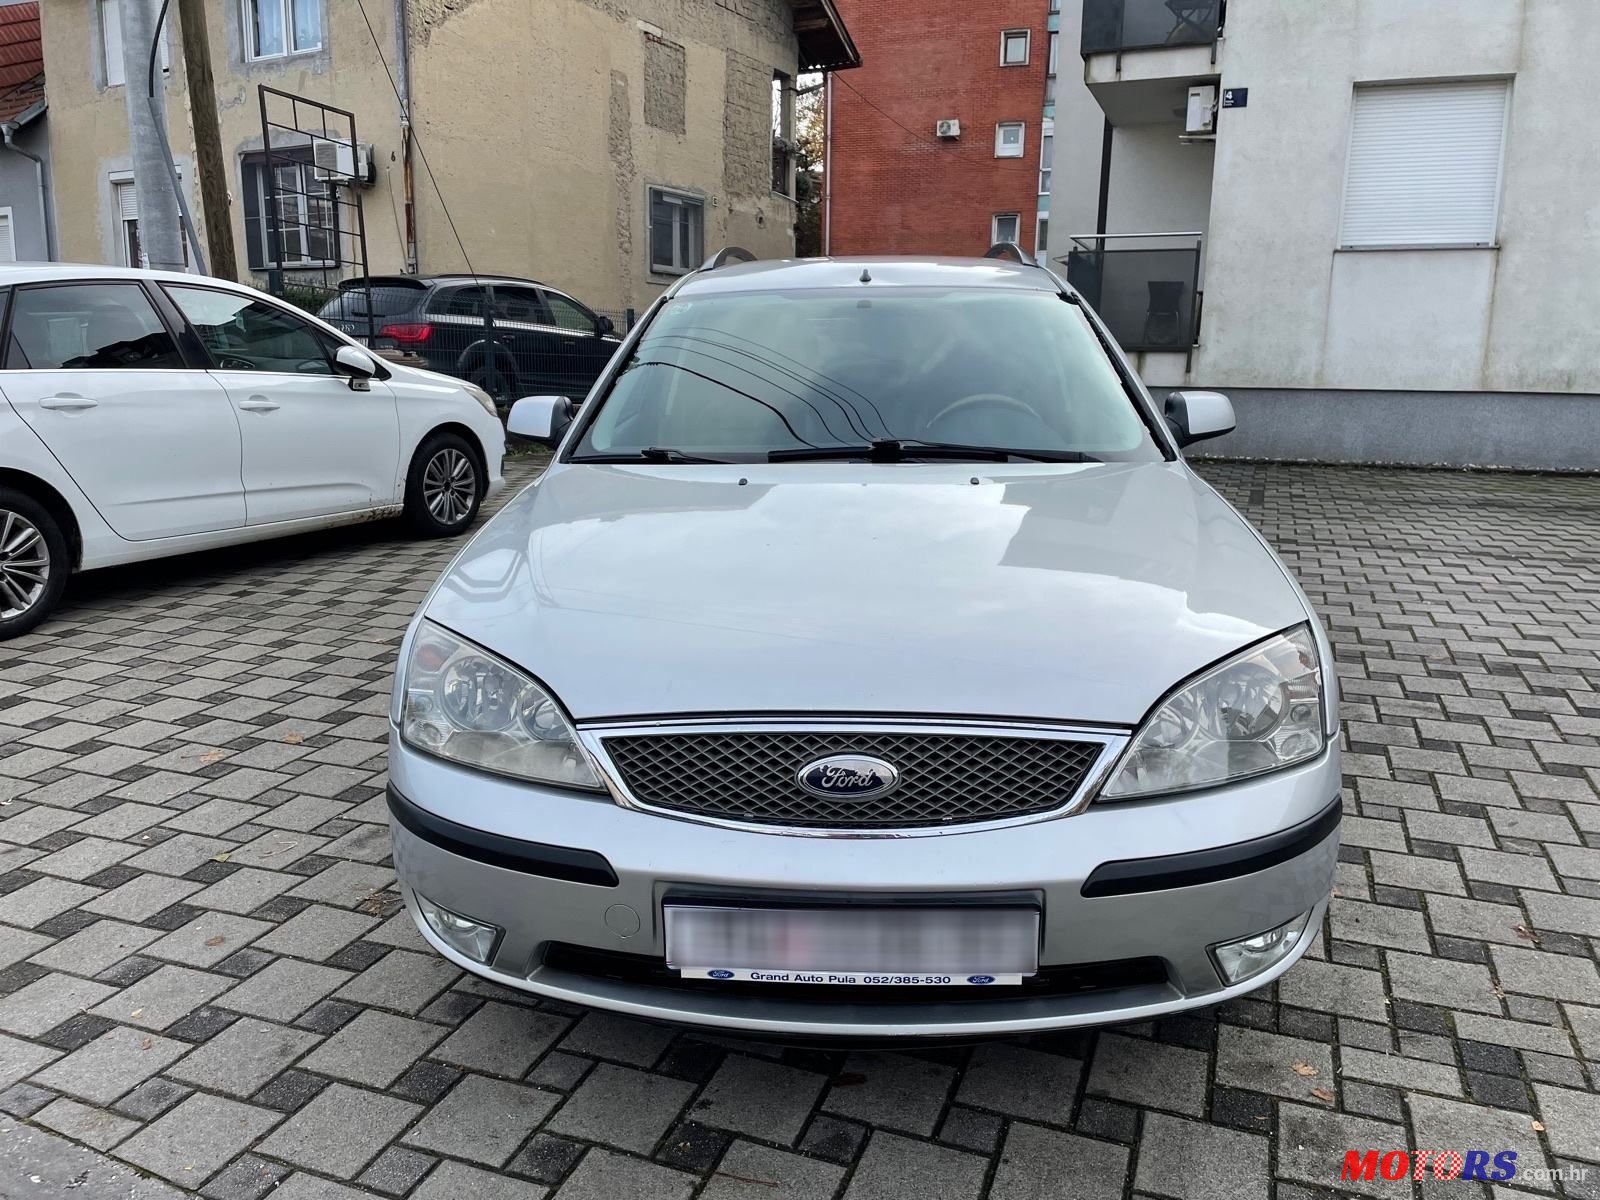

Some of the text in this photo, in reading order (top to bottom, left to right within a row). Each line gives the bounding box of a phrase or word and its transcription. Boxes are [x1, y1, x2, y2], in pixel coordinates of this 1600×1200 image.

[1225, 90, 1233, 99] 4
[820, 765, 874, 788] Ford
[750, 972, 951, 985] Grand Auto Pula 052/385-530
